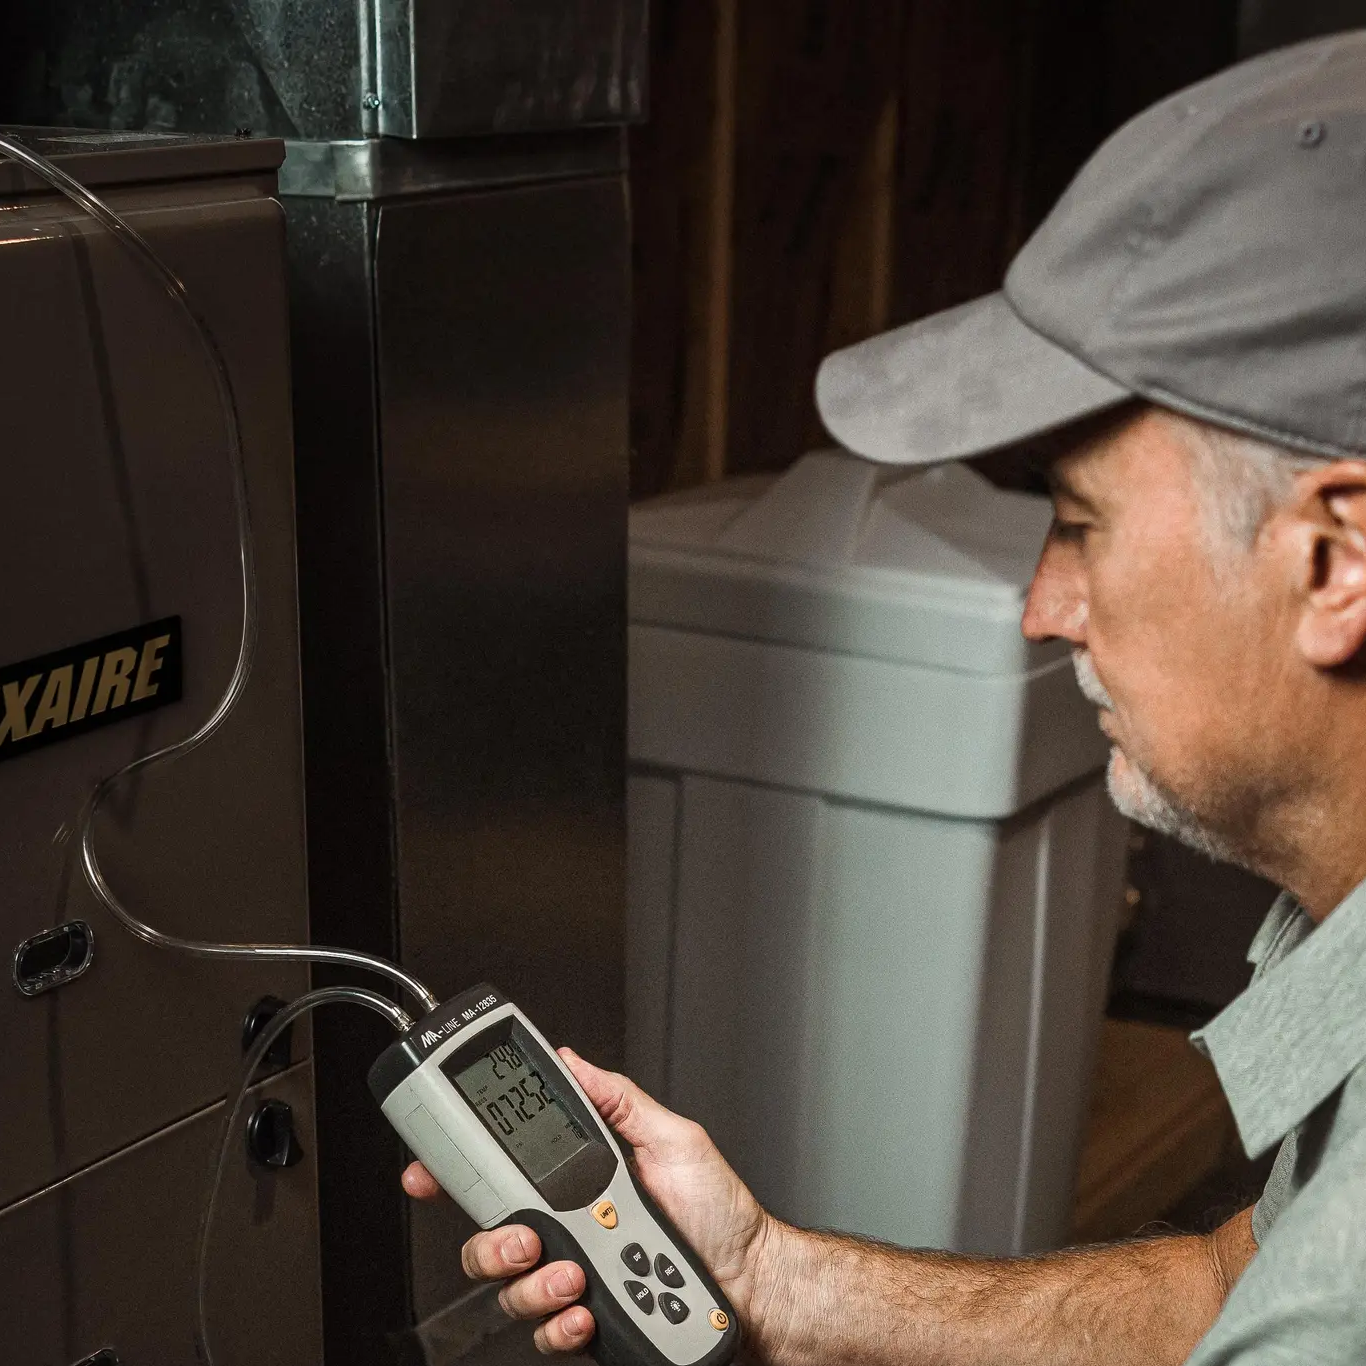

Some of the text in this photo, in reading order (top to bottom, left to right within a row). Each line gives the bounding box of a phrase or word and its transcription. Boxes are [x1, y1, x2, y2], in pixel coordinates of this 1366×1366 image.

[420, 994, 498, 1049] MA-LINE MA-12835
[600, 1206, 614, 1219] UNITS
[664, 1265, 675, 1277] REC
[635, 1287, 649, 1301] HOLD
